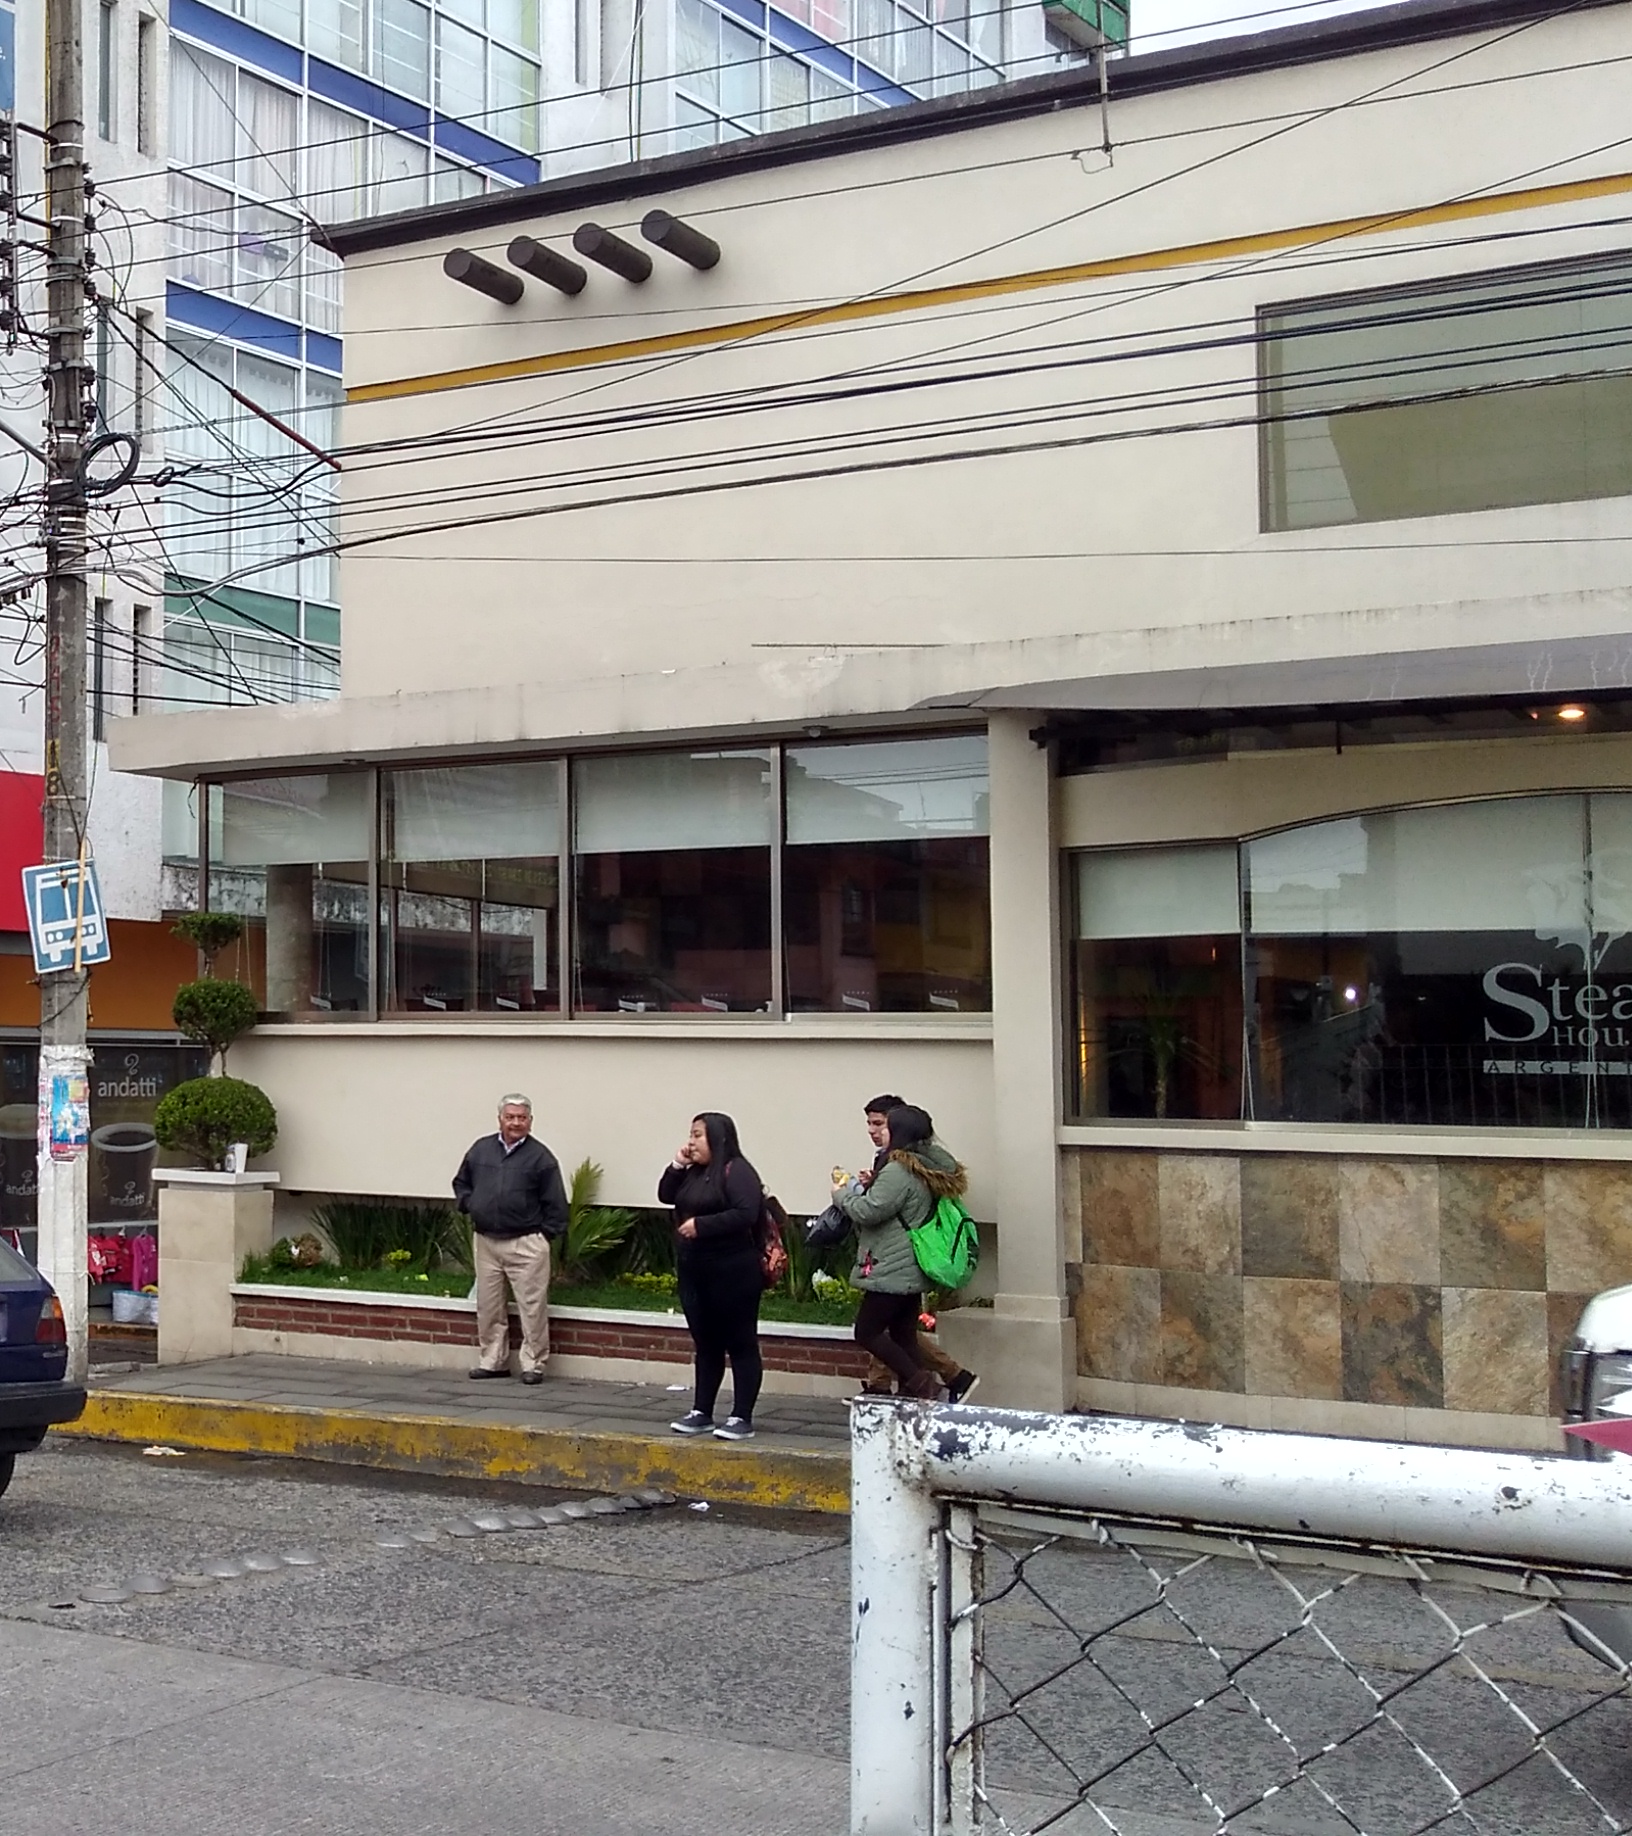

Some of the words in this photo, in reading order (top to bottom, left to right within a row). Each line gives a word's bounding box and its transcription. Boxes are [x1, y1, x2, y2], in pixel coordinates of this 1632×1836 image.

[1551, 1025, 1631, 1047] HOU
[98, 1076, 156, 1097] andatti
[110, 1191, 145, 1207] andatti
